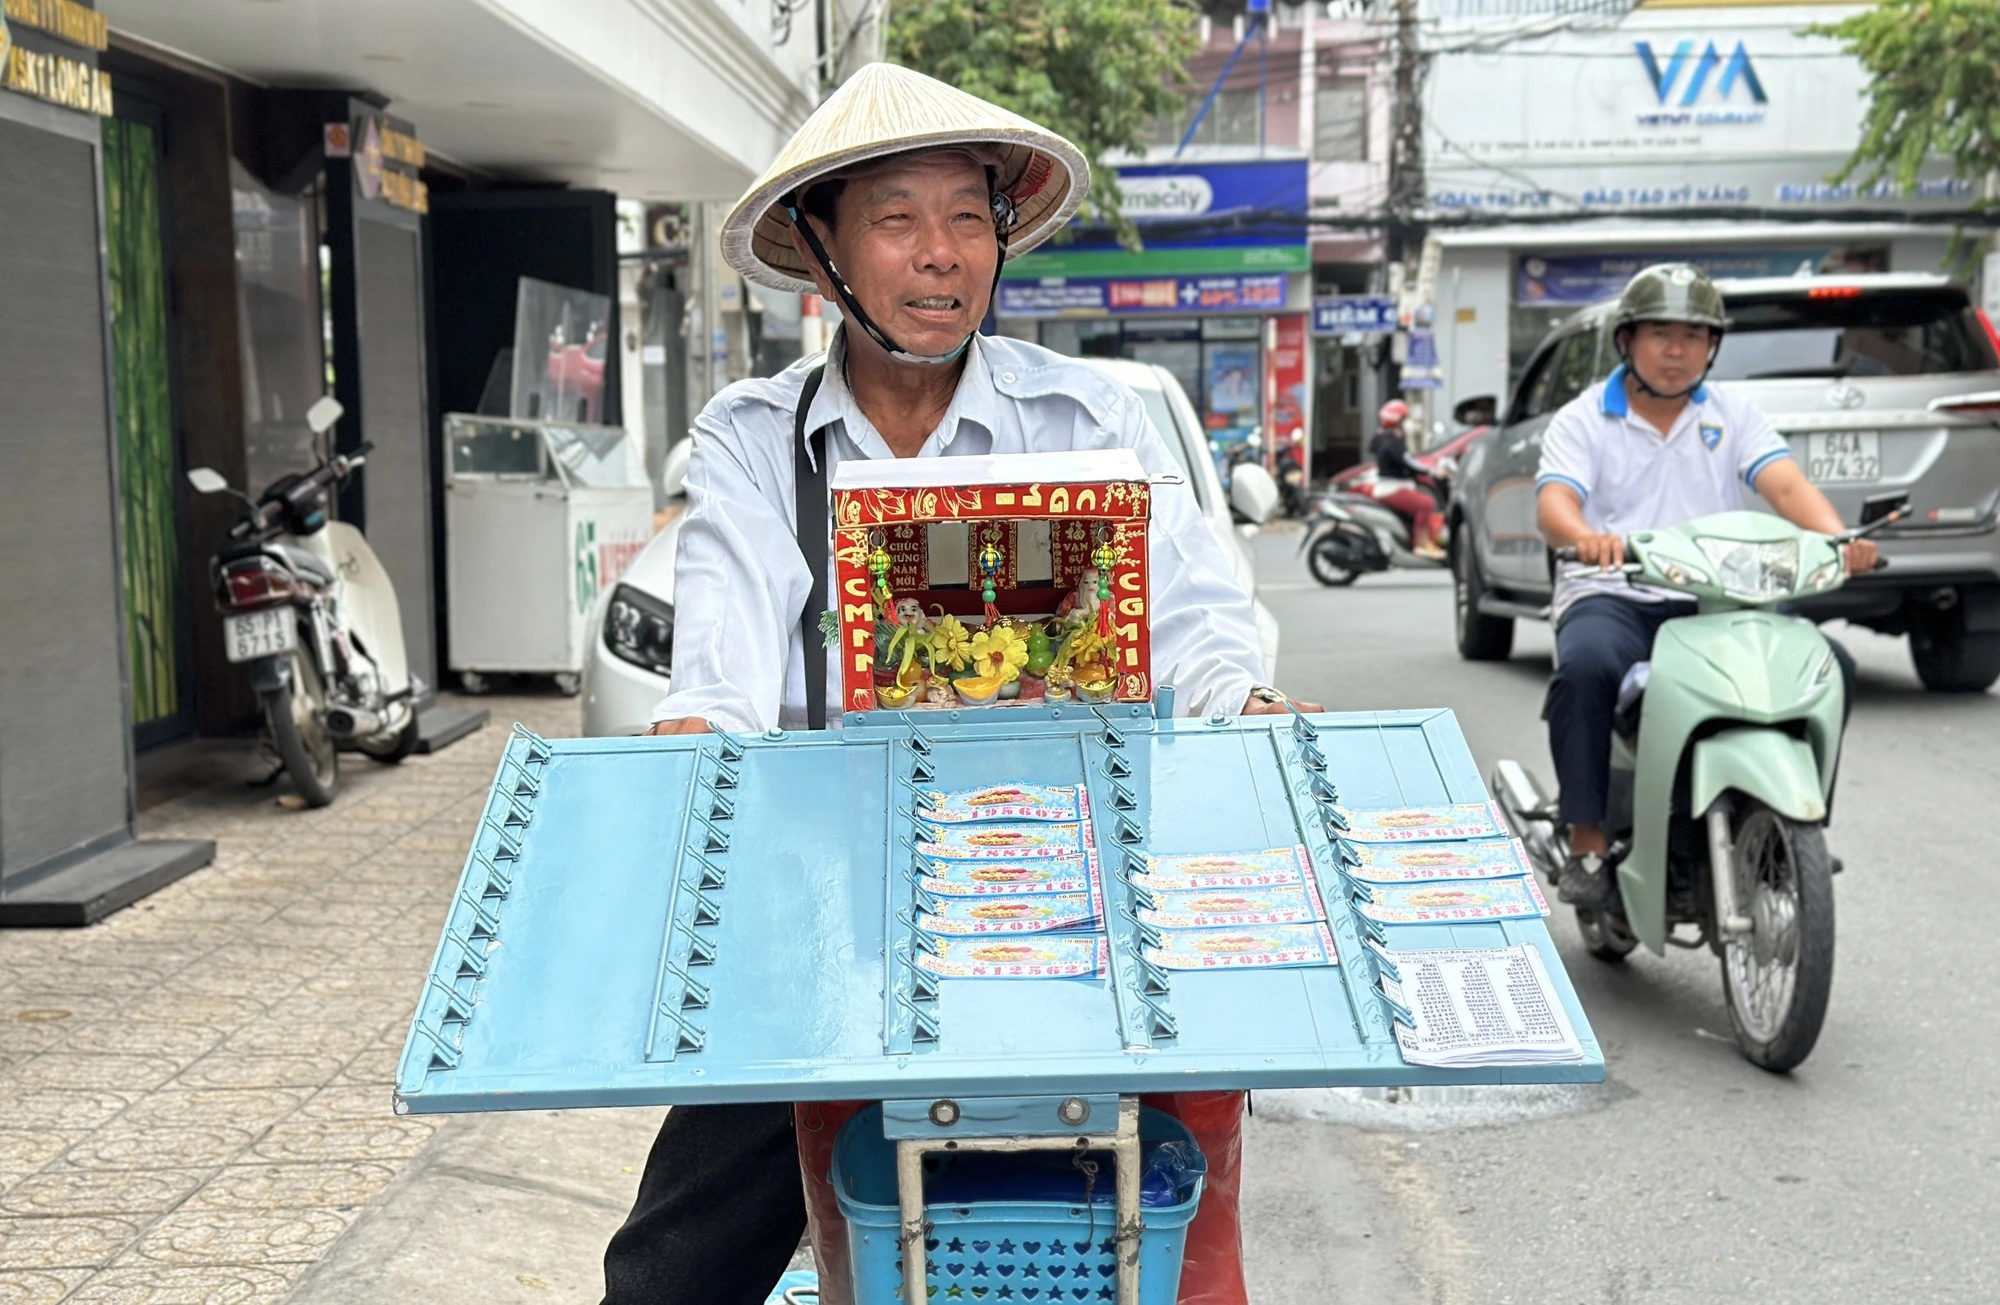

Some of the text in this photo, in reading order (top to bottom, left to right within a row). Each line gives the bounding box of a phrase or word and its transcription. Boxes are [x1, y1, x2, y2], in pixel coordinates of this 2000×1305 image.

[47, 53, 90, 111] LONG
[91, 67, 113, 117] AN
[1825, 431, 1862, 454] 64A
[889, 540, 919, 551] CHÚC
[1063, 542, 1089, 554] VẠN
[1068, 553, 1085, 564] SỰ
[893, 564, 918, 575] NĂM
[895, 576, 916, 587] MỚI
[974, 917, 1075, 931] 37032
